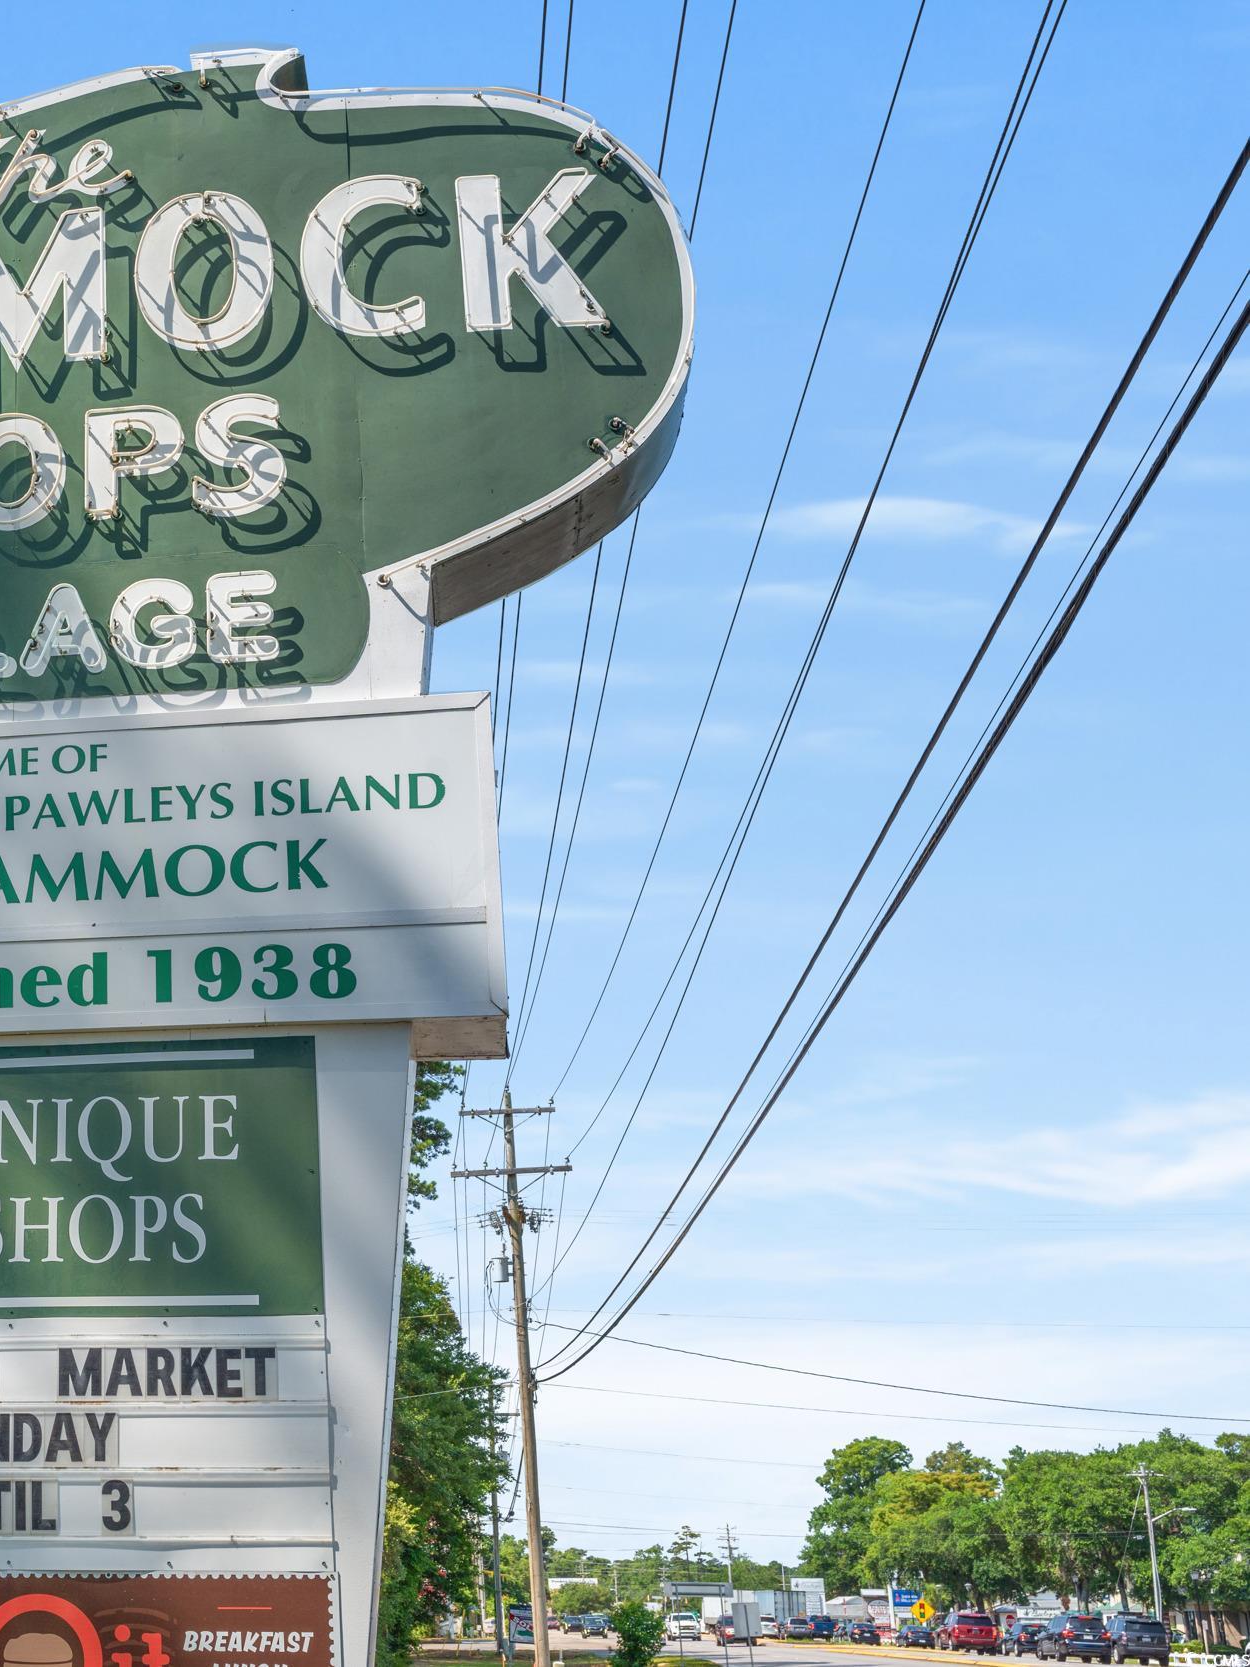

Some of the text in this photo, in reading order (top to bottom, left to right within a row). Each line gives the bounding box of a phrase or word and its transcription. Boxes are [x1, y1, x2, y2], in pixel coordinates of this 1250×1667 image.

[51, 743, 108, 774] OF
[4, 783, 235, 831] PAWLEYS
[253, 772, 446, 817] ISLAND
[146, 943, 357, 1003] 1938
[58, 1346, 277, 1398] MARKET
[101, 1479, 132, 1532] 3
[182, 1630, 315, 1654] BREAKFAST
